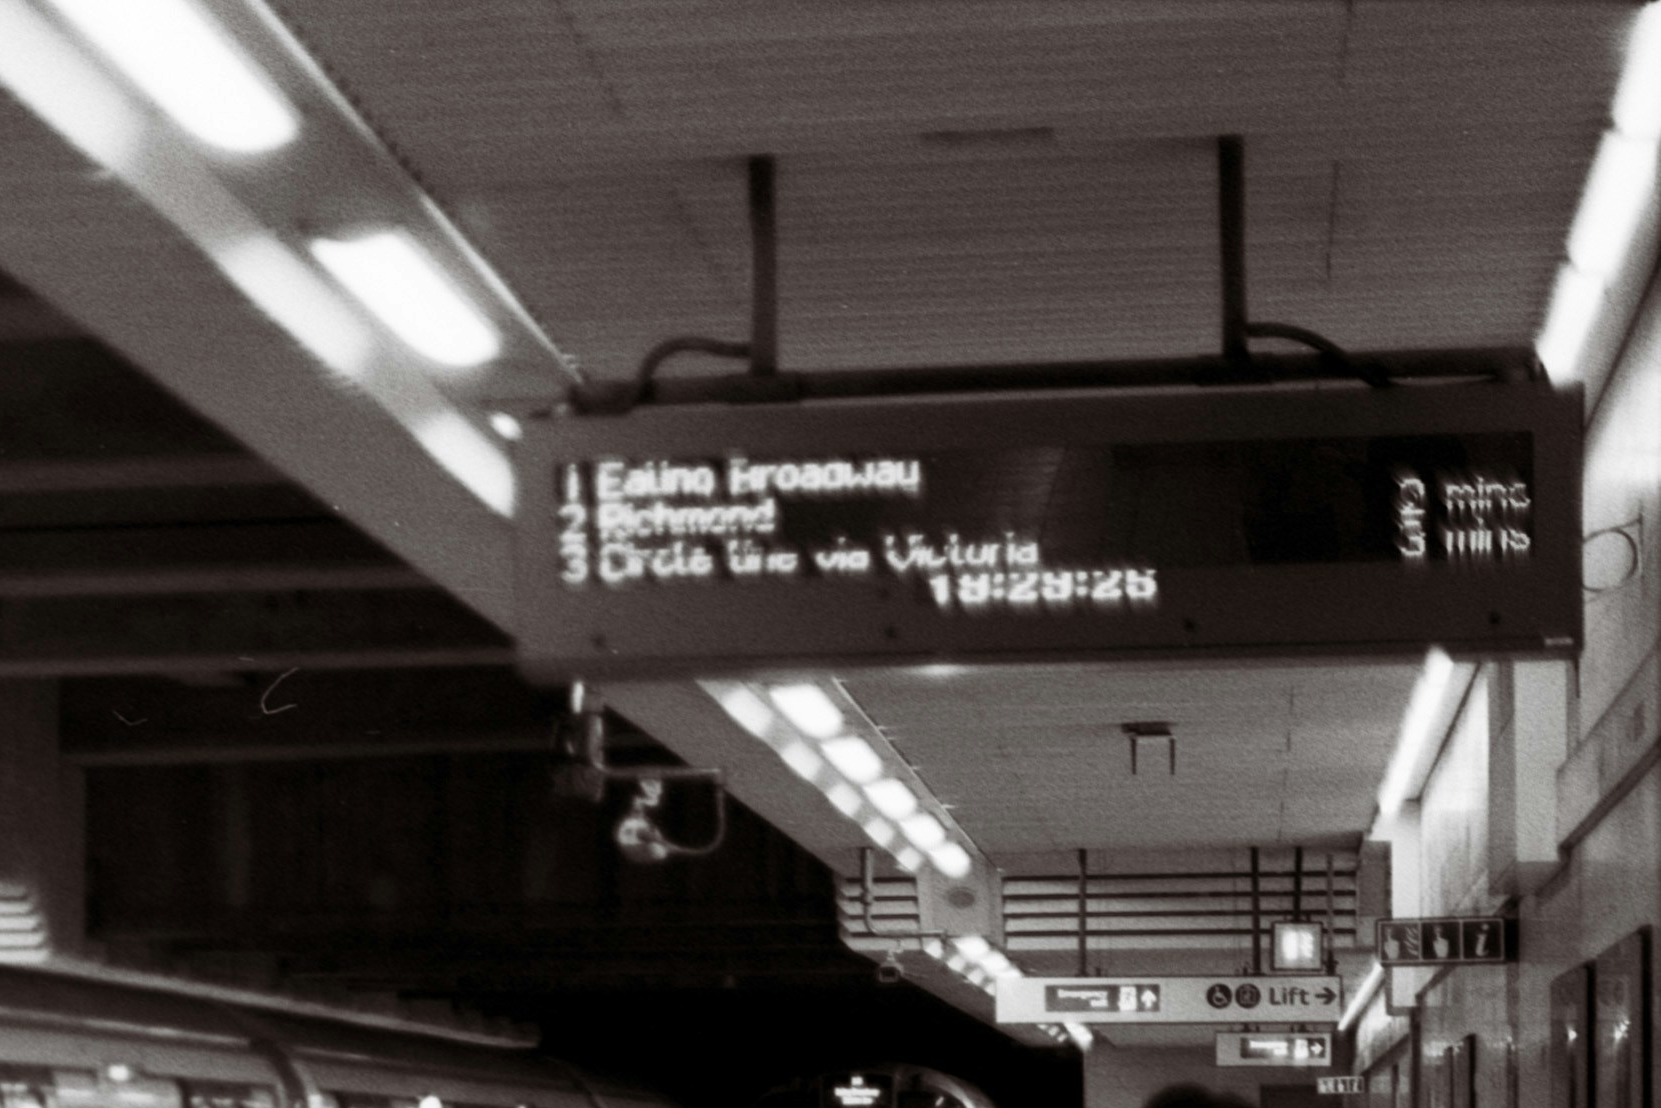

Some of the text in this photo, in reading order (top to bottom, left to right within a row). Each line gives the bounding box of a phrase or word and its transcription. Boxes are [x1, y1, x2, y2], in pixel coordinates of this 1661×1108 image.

[565, 462, 581, 501] 1
[558, 502, 587, 541] 2
[597, 499, 776, 542] Richmond
[1445, 474, 1531, 512] mins
[559, 542, 587, 584] 3
[814, 537, 870, 572] via
[1269, 985, 1310, 1006] Lift
